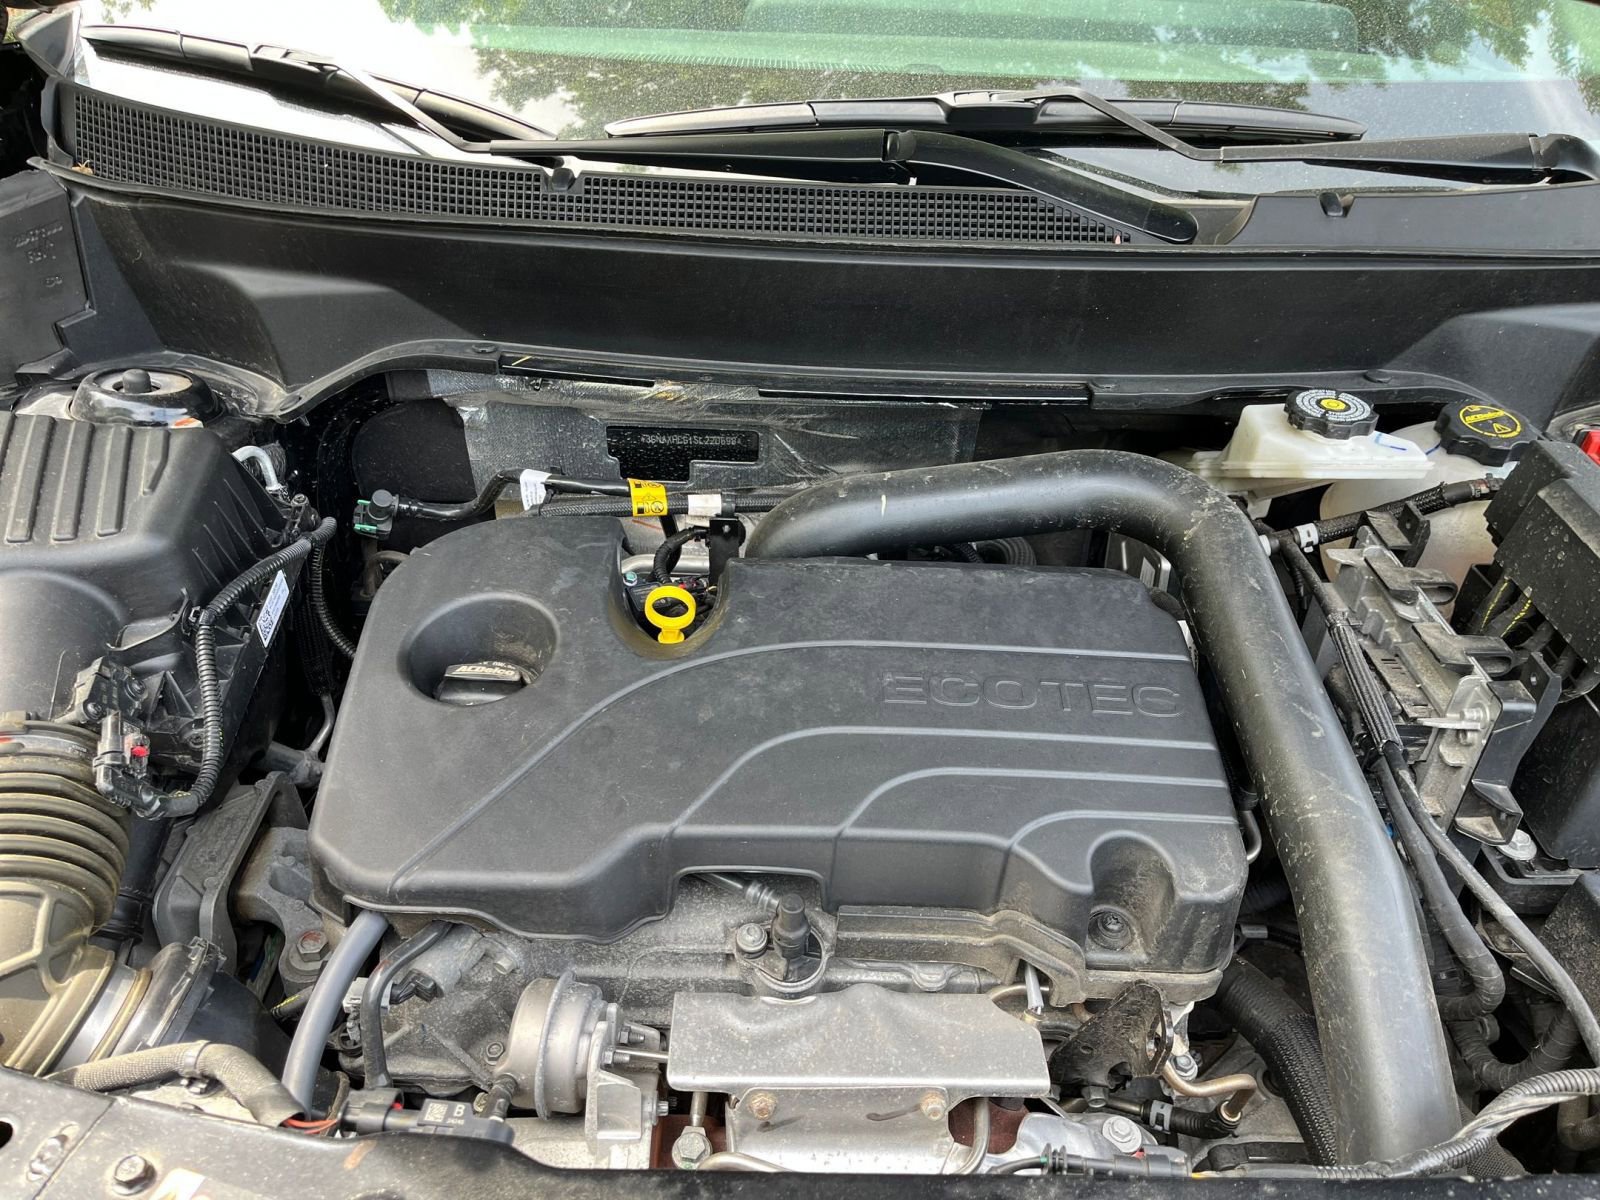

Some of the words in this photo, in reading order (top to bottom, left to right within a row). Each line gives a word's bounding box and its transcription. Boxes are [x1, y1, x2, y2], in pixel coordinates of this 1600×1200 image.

[455, 665, 515, 676] ACDelco
[882, 671, 1183, 718] ECOTEC
[453, 1104, 466, 1117] B
